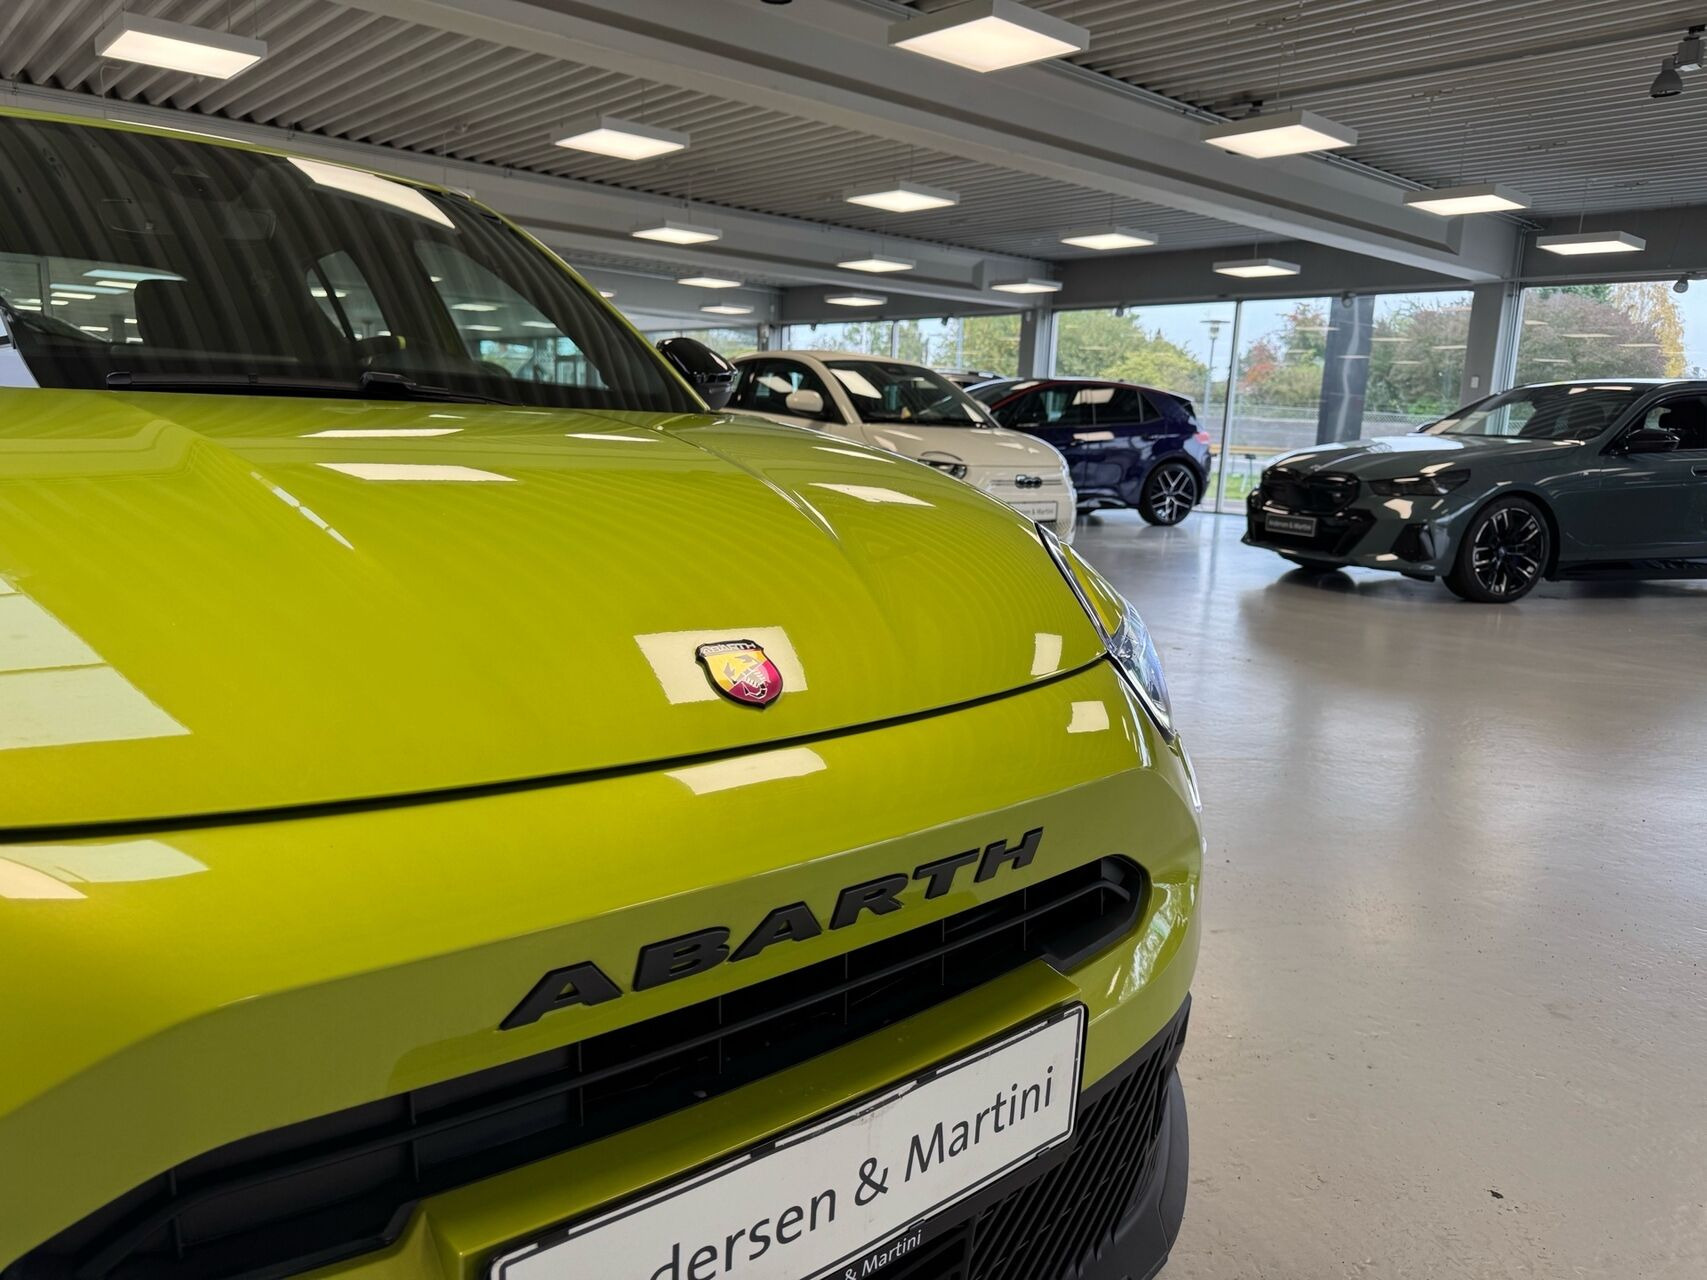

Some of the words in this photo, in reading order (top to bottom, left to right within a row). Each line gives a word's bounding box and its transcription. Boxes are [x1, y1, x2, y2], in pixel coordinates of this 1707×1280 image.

[700, 643, 757, 656] ABARTH
[499, 827, 1043, 1031] ABARTH
[855, 1157, 888, 1206] &
[905, 1065, 1053, 1182] Martini
[861, 1229, 922, 1277] Martini
